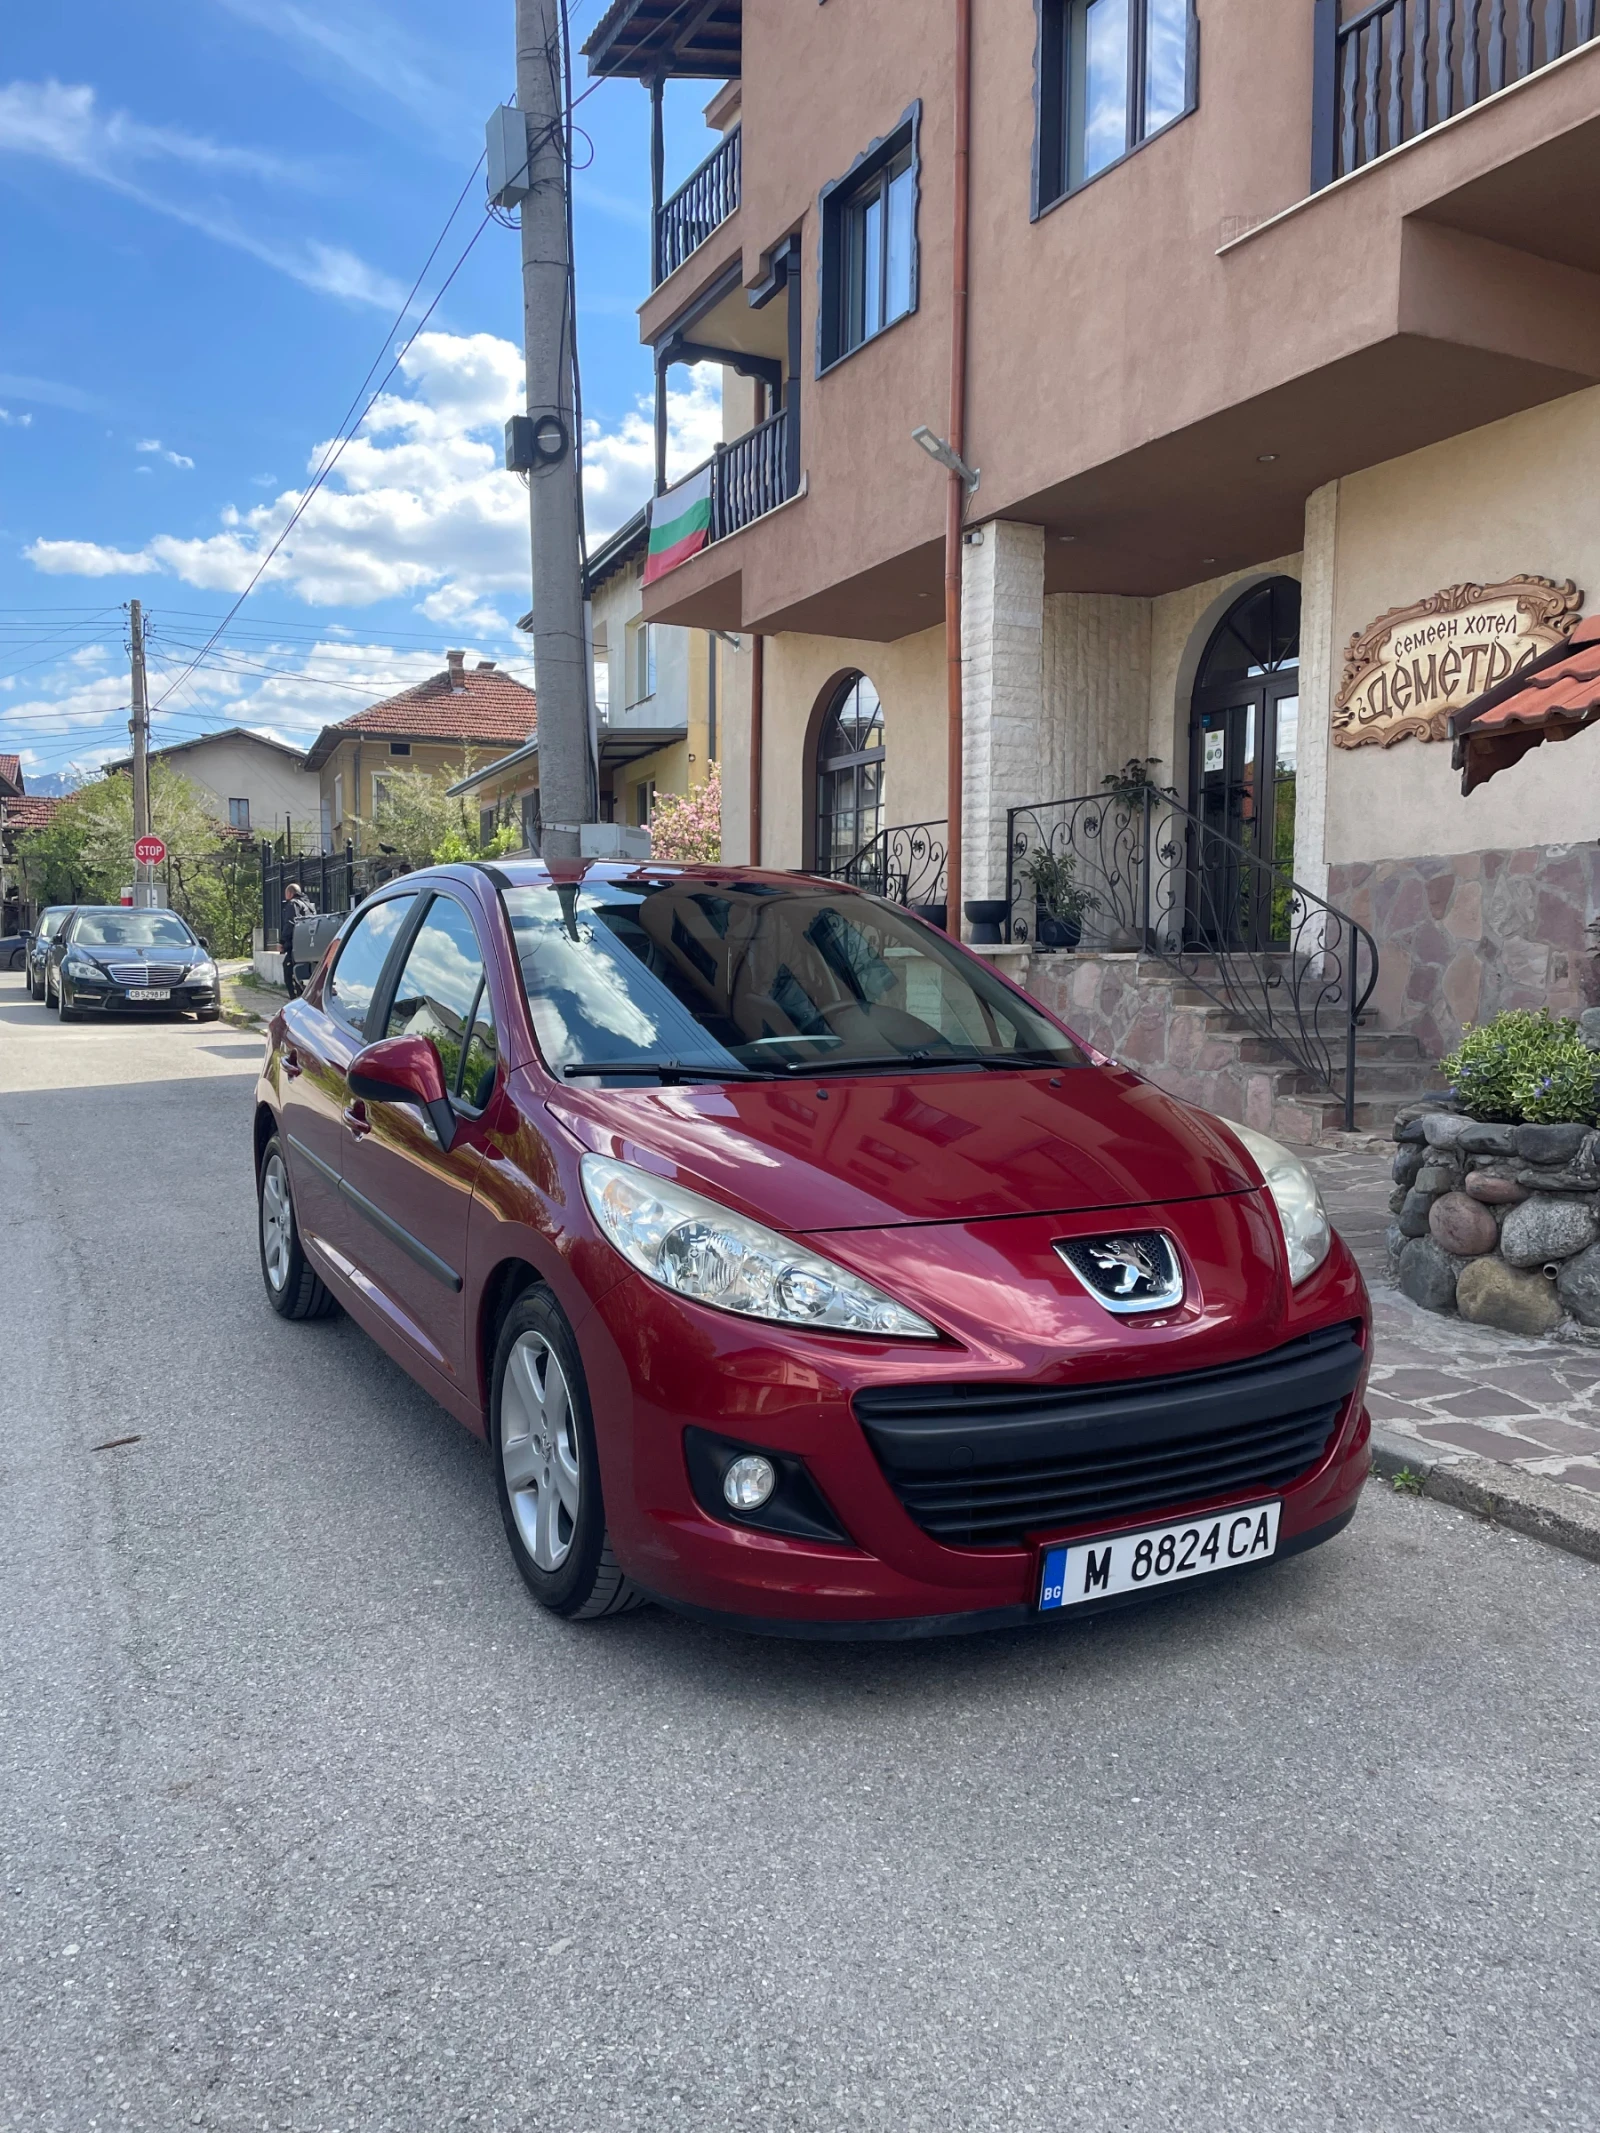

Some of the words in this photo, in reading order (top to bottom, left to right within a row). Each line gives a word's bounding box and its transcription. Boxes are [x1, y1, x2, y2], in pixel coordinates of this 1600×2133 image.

[138, 845, 163, 856] STOP
[1044, 1585, 1062, 1600] BG
[1083, 1546, 1112, 1594] M
